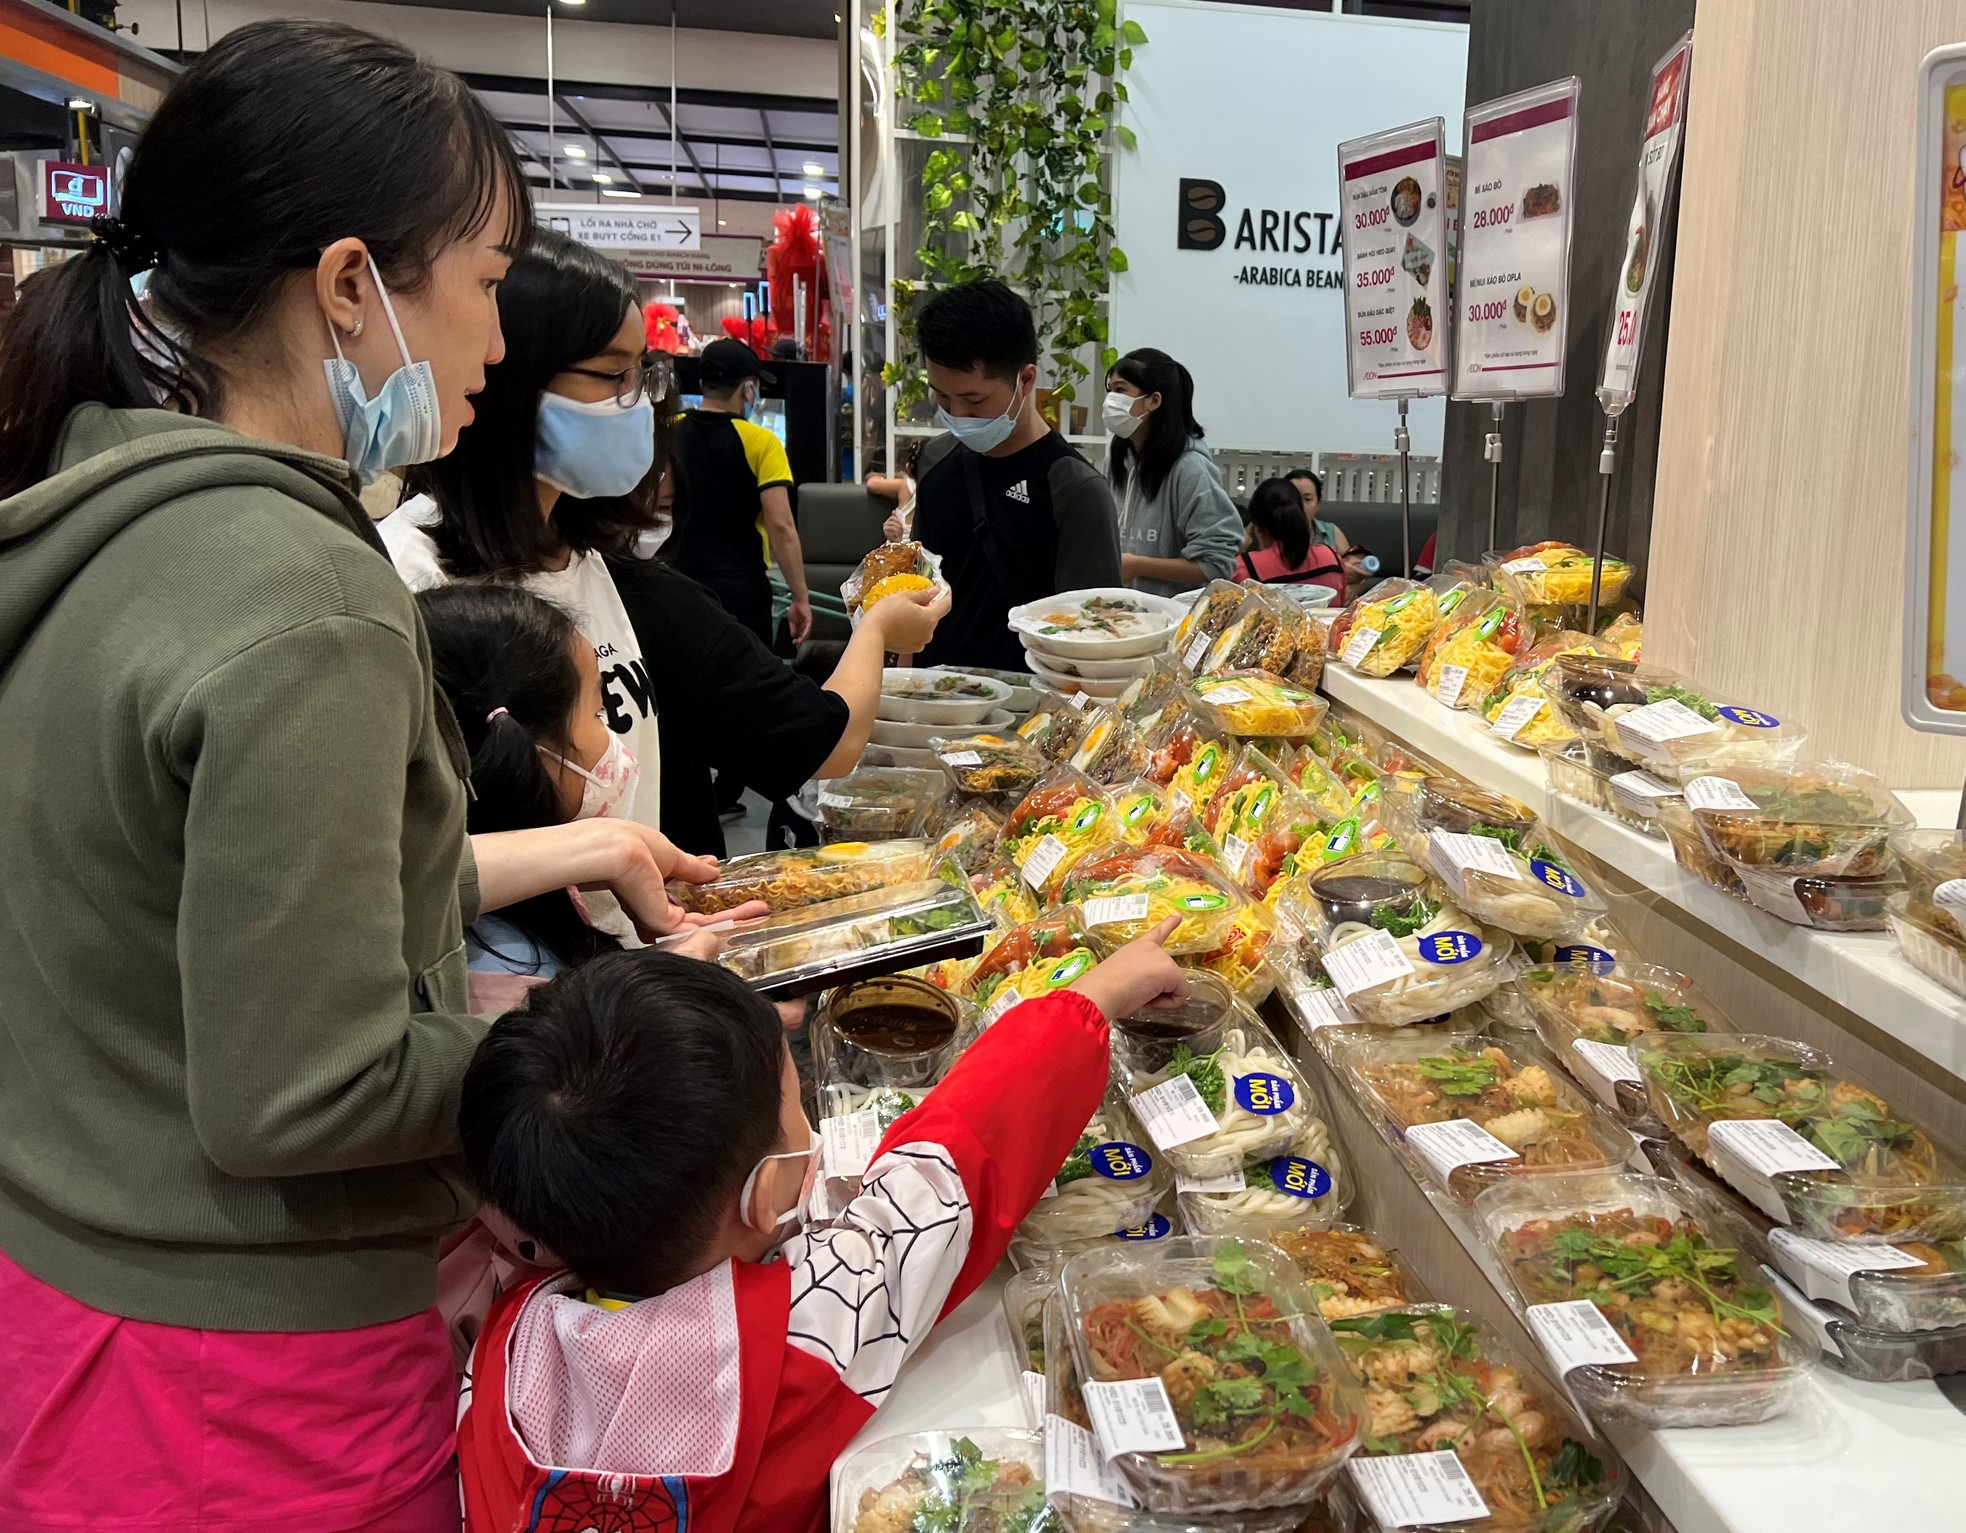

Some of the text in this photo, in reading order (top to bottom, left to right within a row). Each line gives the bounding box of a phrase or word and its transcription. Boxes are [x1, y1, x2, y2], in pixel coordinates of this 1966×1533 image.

[62, 203, 95, 217] VND
[599, 219, 612, 228] RA
[1544, 866, 1567, 890] MỚI
[1434, 936, 1459, 960] MỚI
[1249, 1078, 1272, 1109] MỚI
[1103, 1148, 1131, 1176] MỚI
[1285, 1161, 1308, 1191] MỚI
